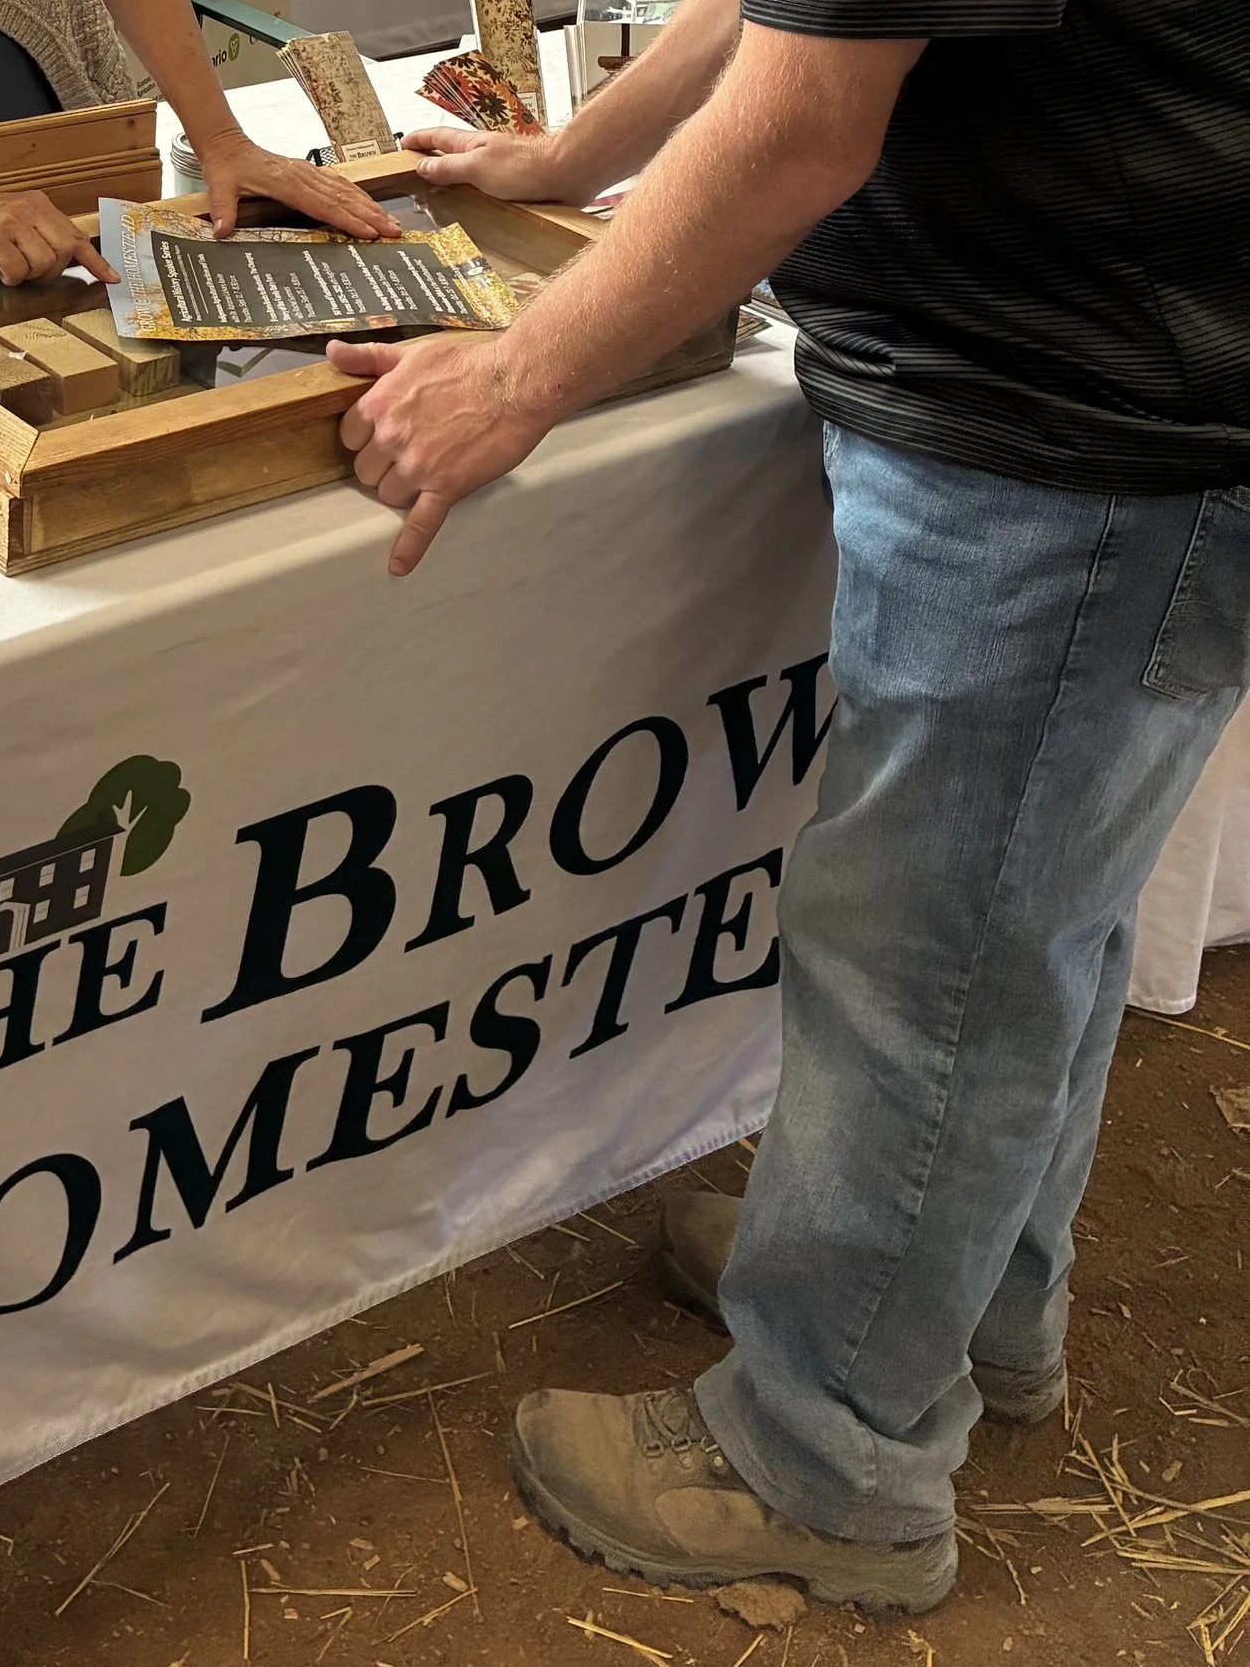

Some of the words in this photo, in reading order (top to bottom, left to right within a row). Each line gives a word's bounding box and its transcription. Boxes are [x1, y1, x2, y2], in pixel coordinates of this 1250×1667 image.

[121, 214, 142, 281] HOMESTEAD
[160, 240, 172, 258] Series
[164, 259, 178, 277] Speaker
[128, 282, 147, 298] THE
[170, 278, 184, 294] History
